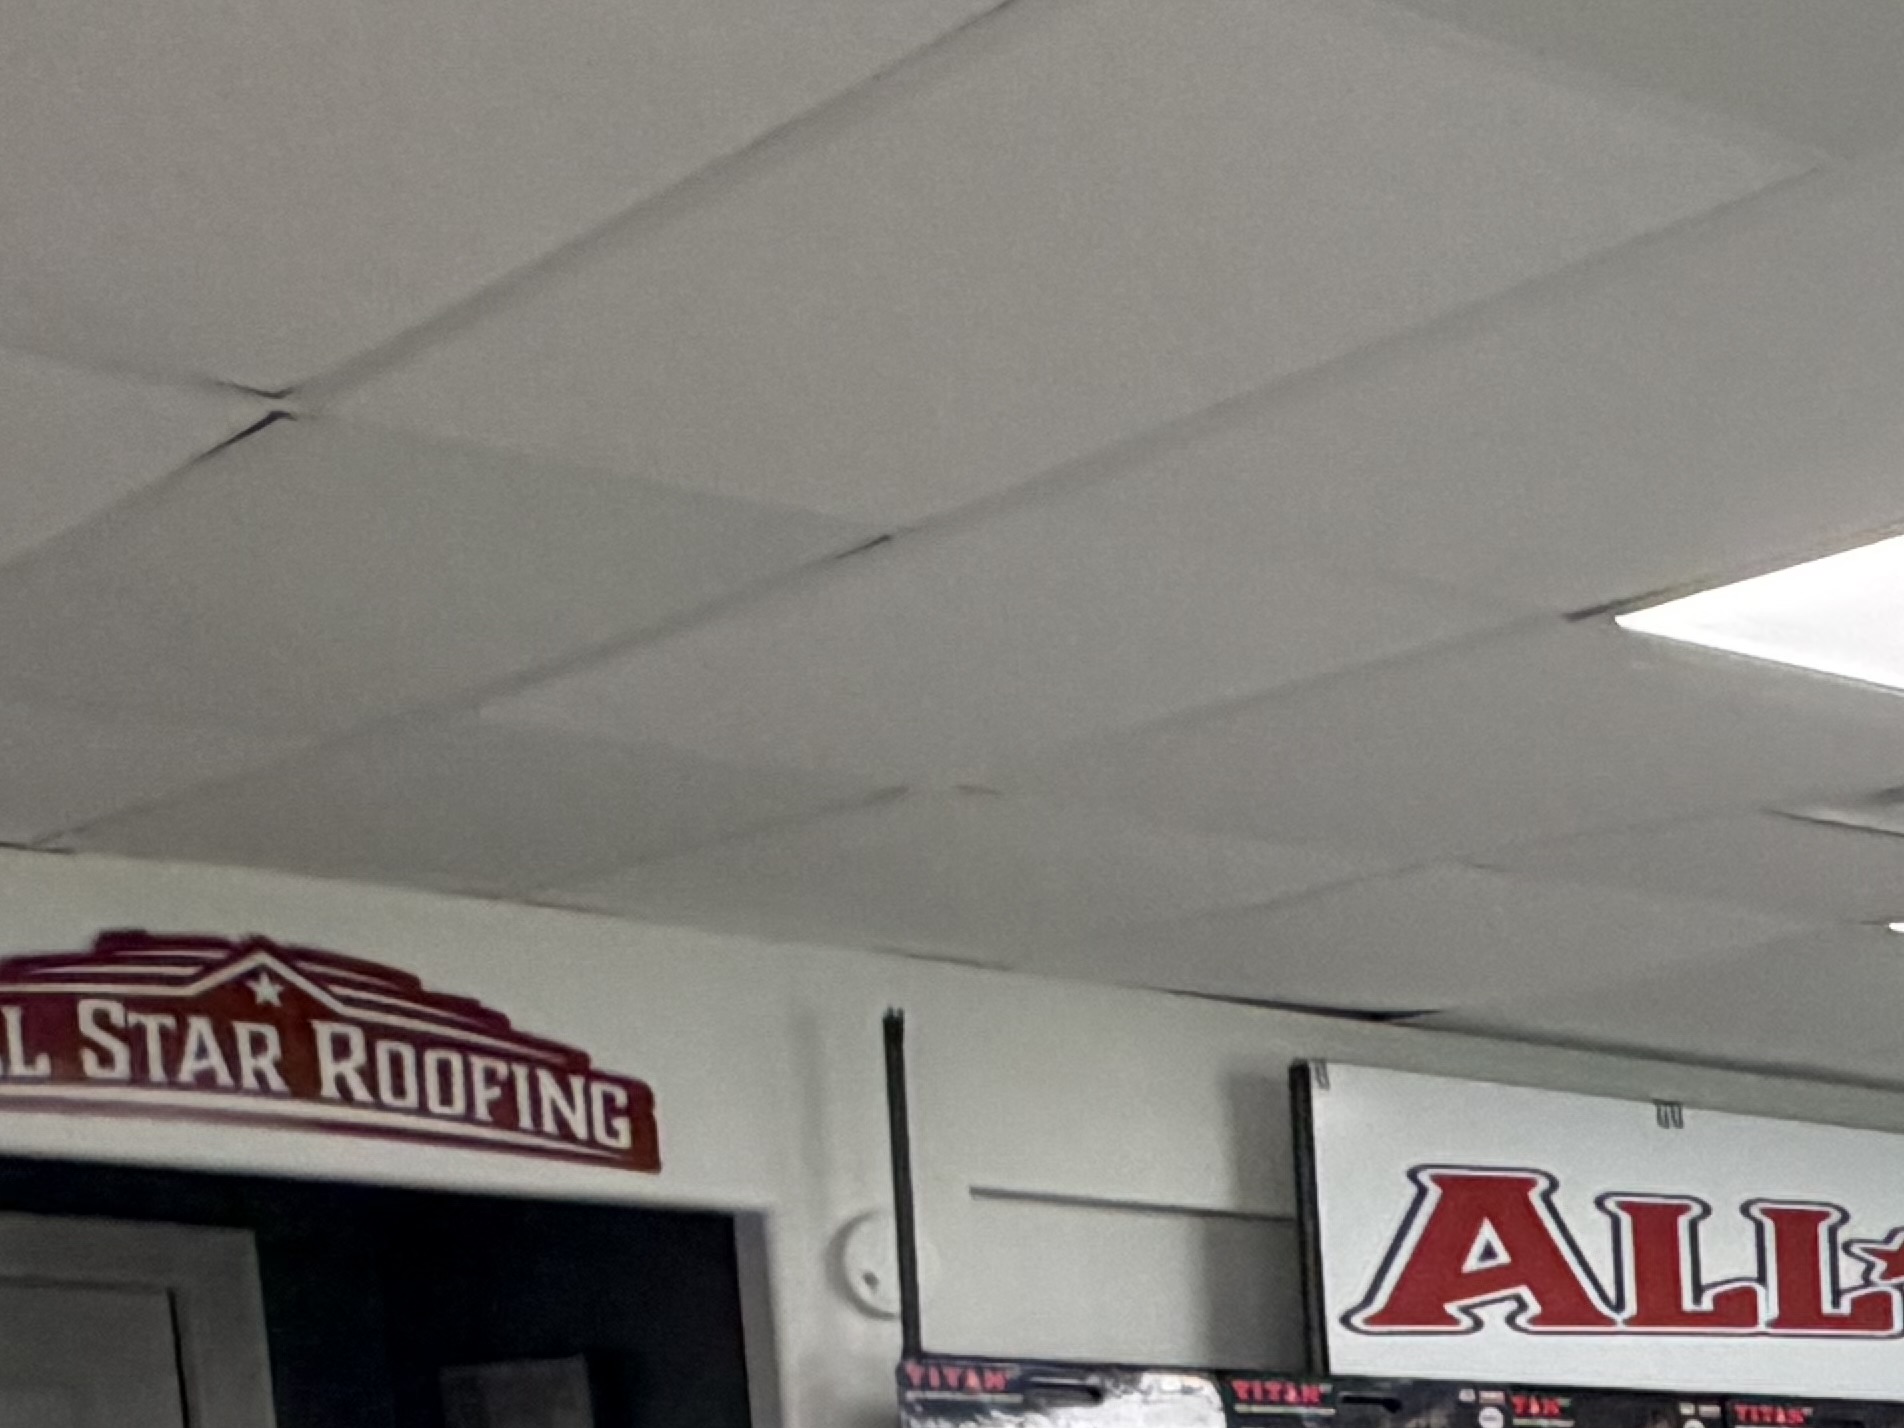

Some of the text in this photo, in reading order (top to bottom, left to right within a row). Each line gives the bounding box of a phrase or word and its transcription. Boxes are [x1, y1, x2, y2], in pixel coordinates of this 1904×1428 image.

[77, 999, 289, 1094] STAR
[312, 1018, 633, 1151] ROOFING
[904, 1361, 1008, 1392] TITAN
[1231, 1379, 1323, 1405] TITAN
[1511, 1394, 1563, 1417] TAN
